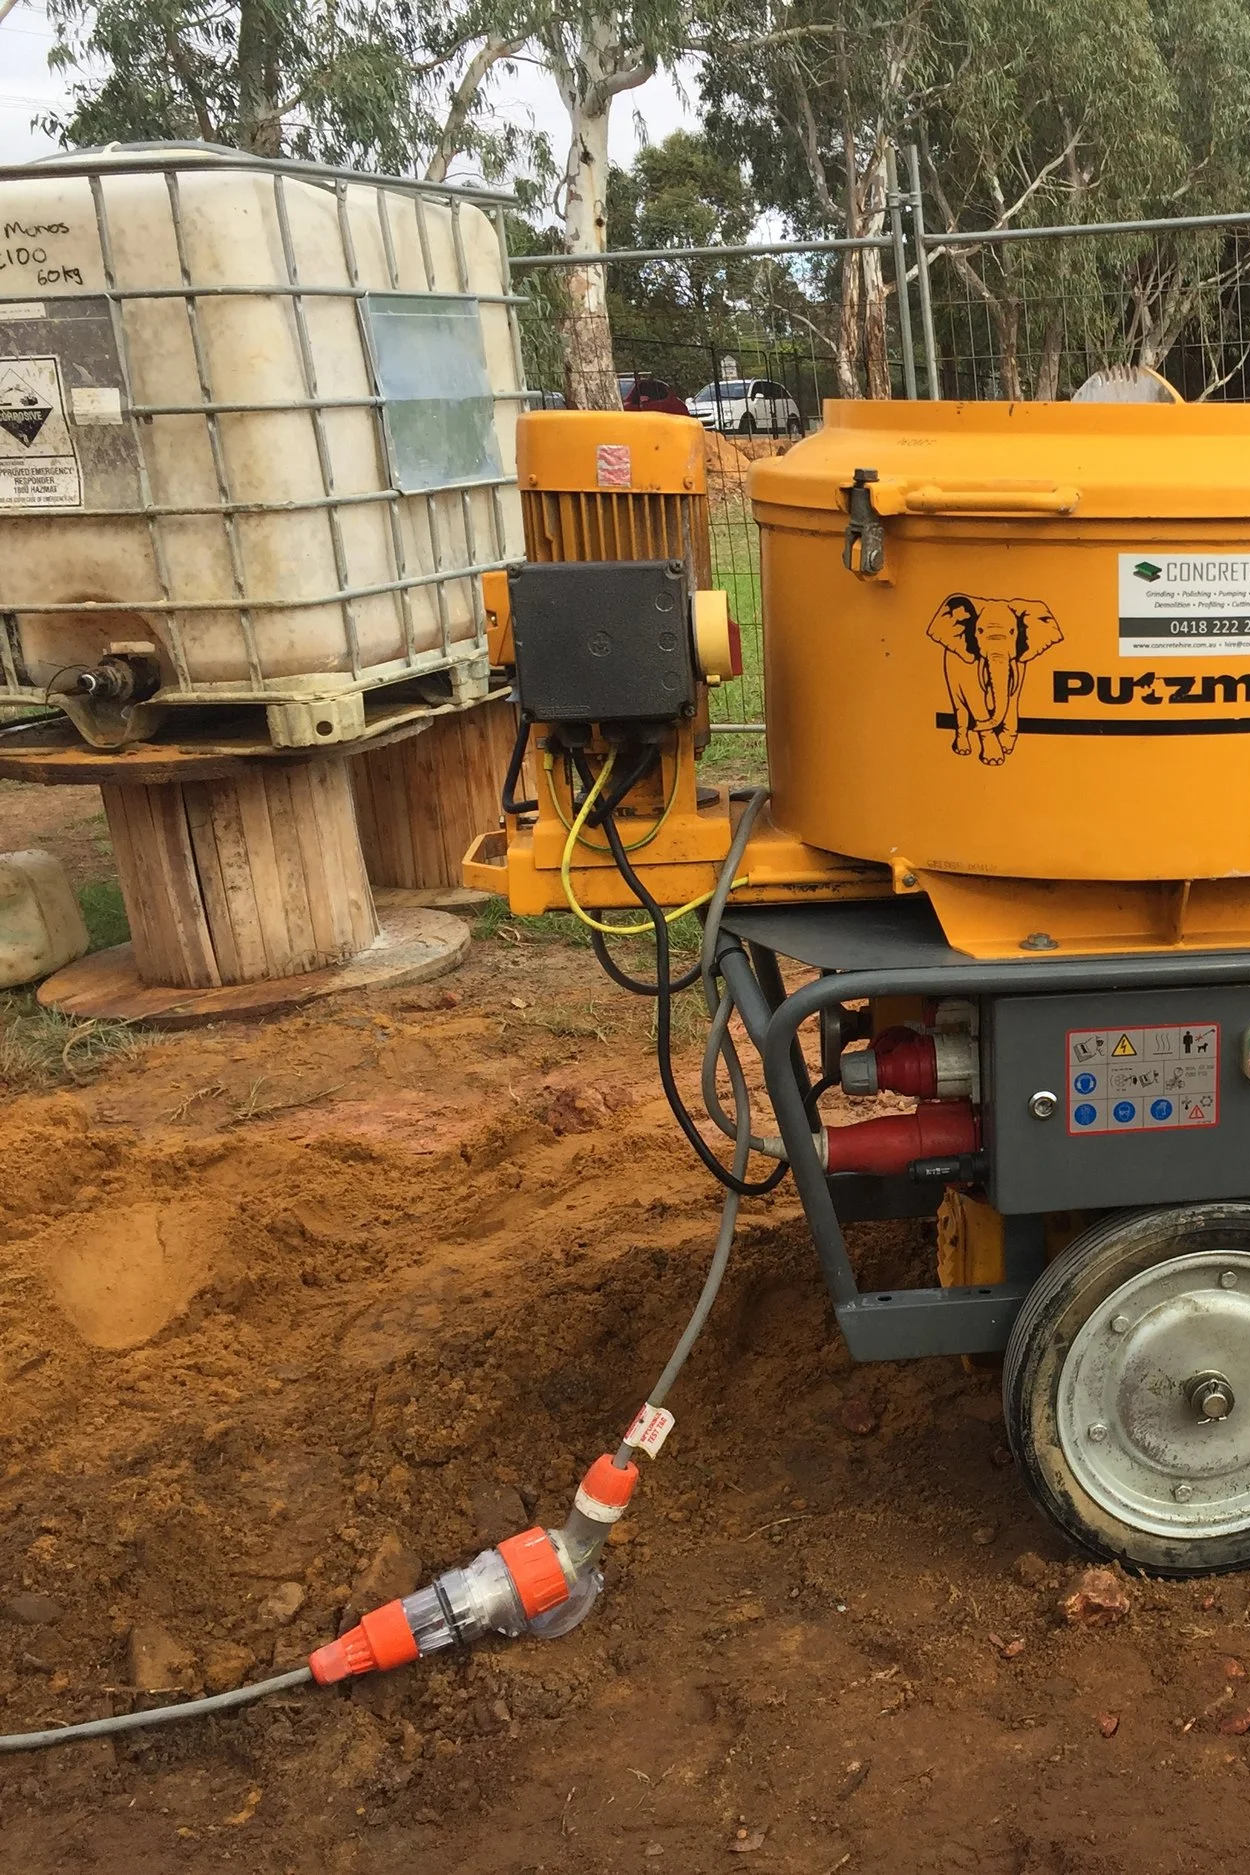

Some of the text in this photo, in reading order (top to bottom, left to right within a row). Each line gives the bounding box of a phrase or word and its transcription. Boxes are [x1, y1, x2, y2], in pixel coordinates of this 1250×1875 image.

[0, 410, 42, 421] ORROSIVE
[14, 477, 55, 485] RESPONDER
[1146, 590, 1175, 599] Grinding
[1182, 589, 1212, 599] Polishing
[1218, 589, 1247, 598] Pumping
[1154, 600, 1191, 609] Demolition
[1197, 600, 1225, 610] Profiling
[1170, 620, 1208, 634] 0418
[1212, 619, 1239, 633] 222
[1133, 640, 1217, 649] www.concretehire.com.au
